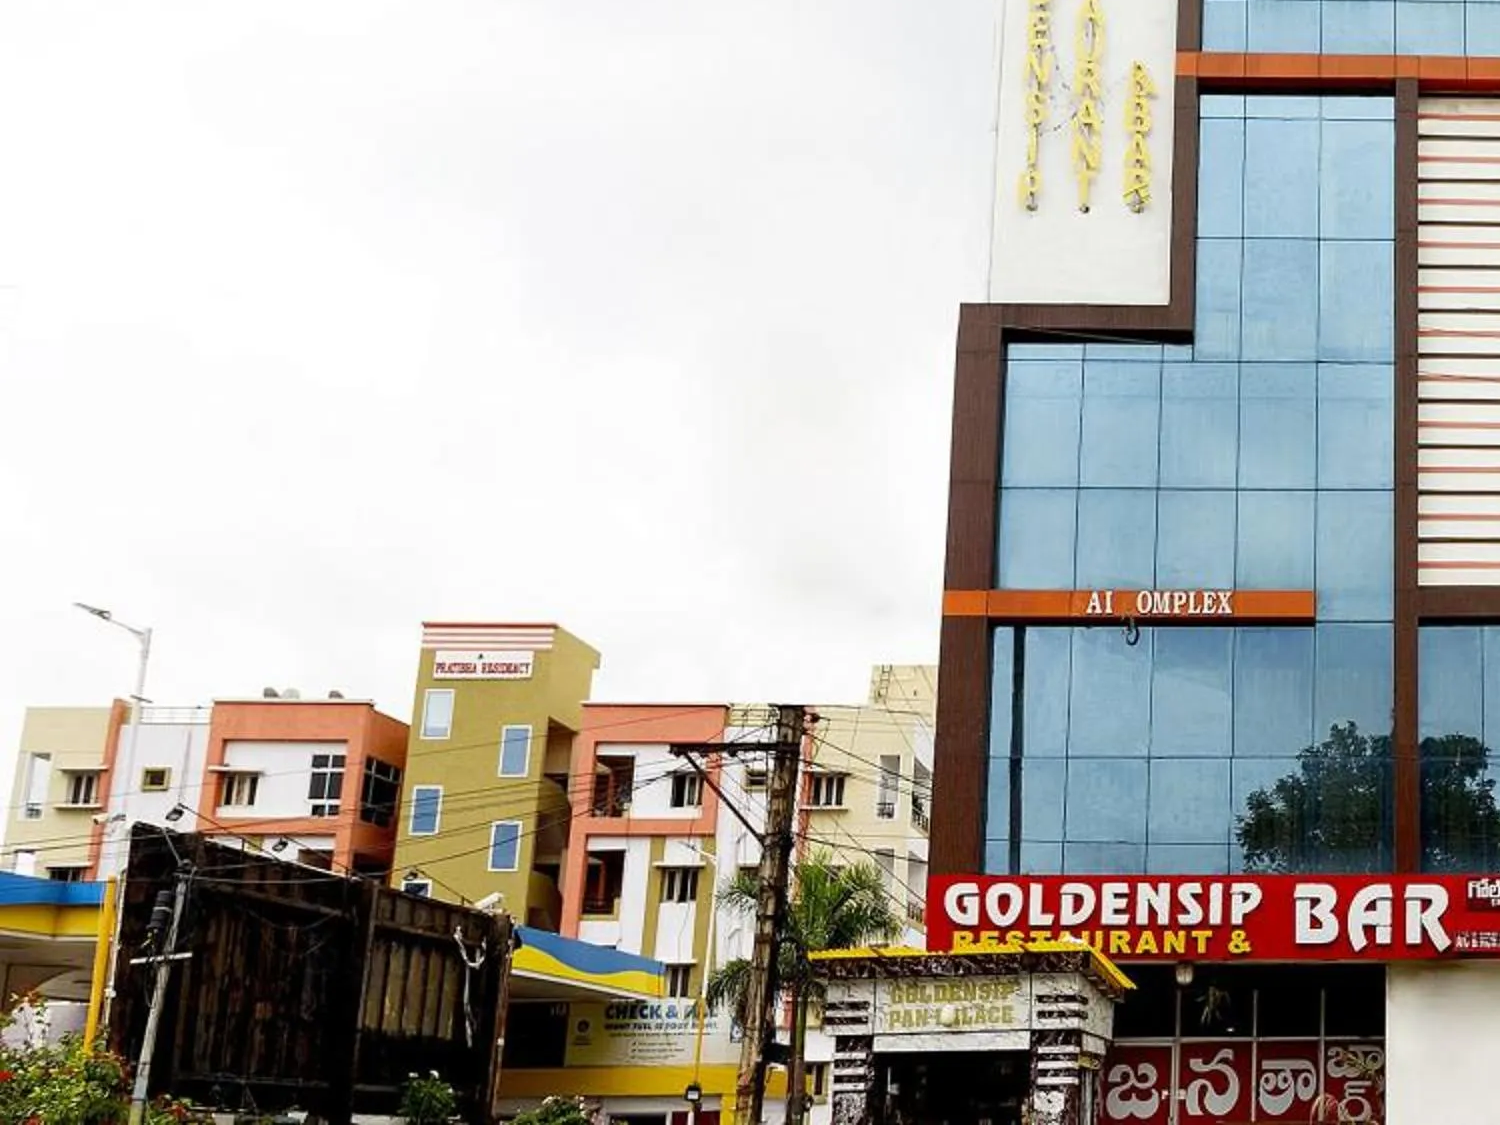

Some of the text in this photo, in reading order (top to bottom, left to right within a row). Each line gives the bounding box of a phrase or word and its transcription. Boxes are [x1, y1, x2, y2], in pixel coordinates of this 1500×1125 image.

[1136, 590, 1233, 615] OMPLEX
[943, 881, 1452, 953] GOLDENSIP BAR
[1227, 930, 1252, 954] &
[604, 1003, 662, 1021] CHECK
[665, 1004, 679, 1020] &
